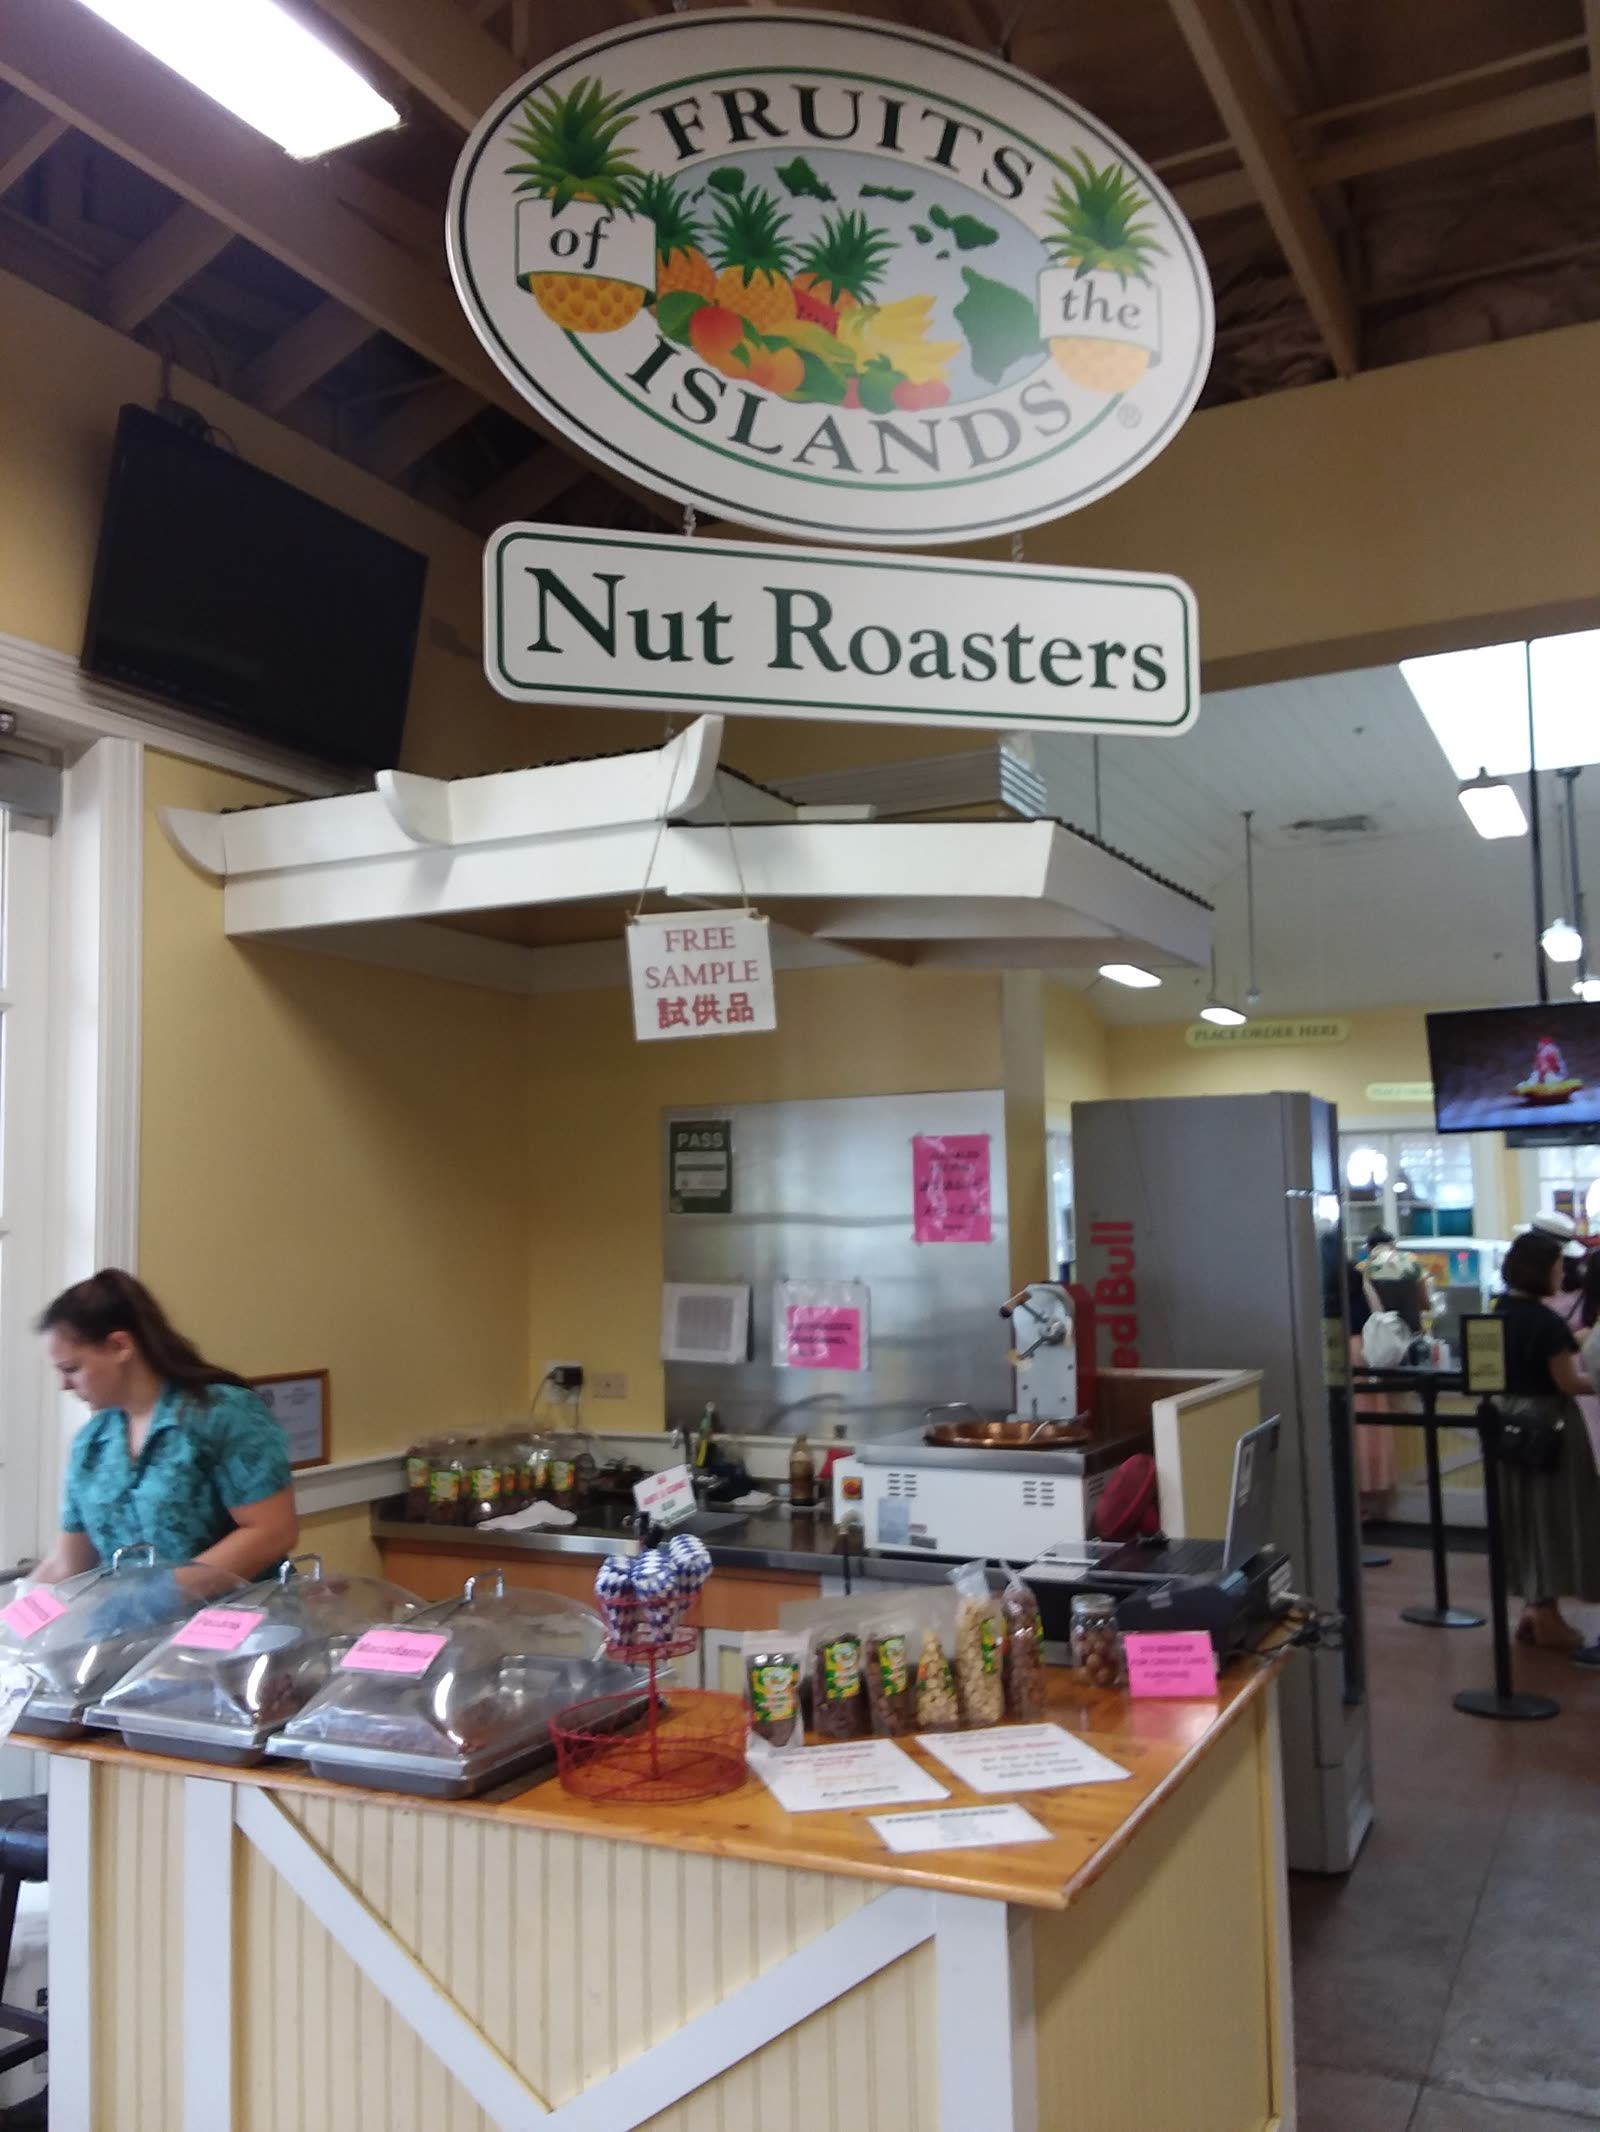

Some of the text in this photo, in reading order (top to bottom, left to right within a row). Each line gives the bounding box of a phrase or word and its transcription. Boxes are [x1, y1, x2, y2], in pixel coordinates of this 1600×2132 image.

[651, 83, 1035, 202] FRUITS
[549, 217, 613, 269] of
[1061, 278, 1142, 331] the
[625, 332, 1072, 475] ISLANDS
[524, 566, 1168, 692] Nut Roasters
[663, 925, 737, 953] FREE
[645, 959, 760, 990] SAMPLE
[656, 991, 755, 1029] 試供品
[1194, 1024, 1340, 1042] PLACE ORDER HERE
[677, 1131, 724, 1149] PASS
[1091, 1221, 1136, 1305] Bull
